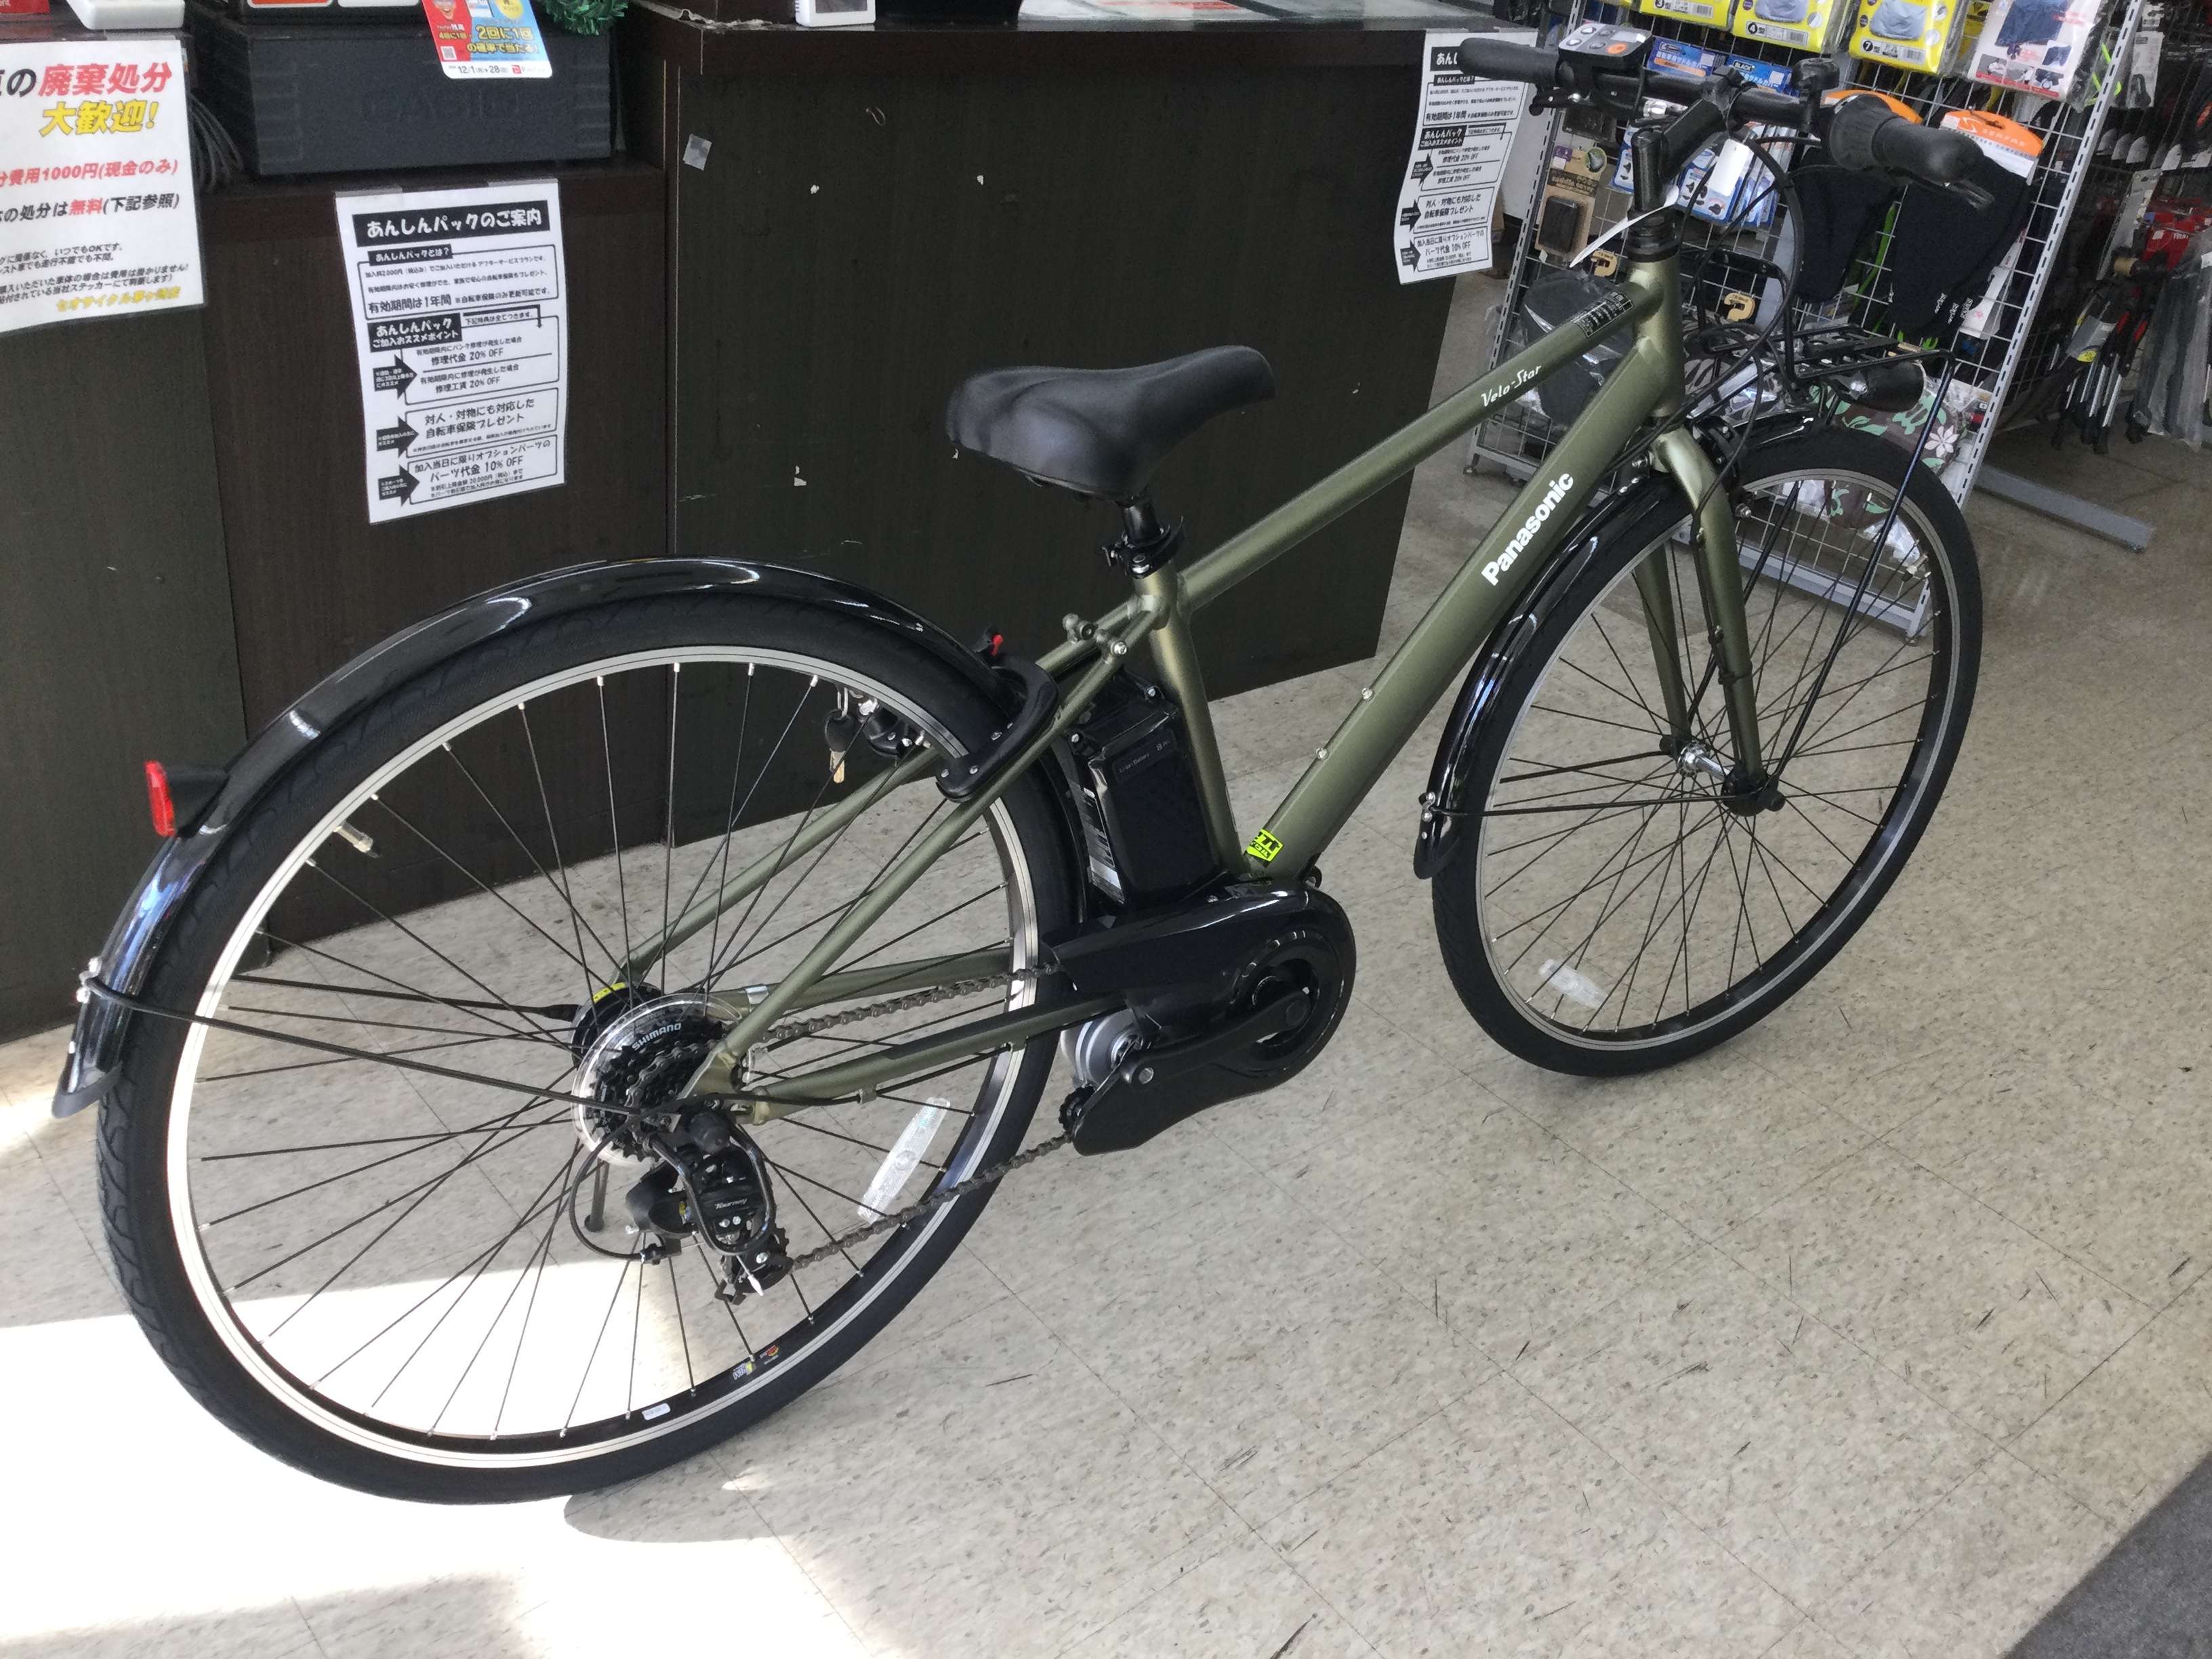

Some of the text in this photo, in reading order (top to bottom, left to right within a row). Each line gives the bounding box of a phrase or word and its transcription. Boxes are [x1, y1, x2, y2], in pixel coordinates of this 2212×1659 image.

[0, 62, 171, 97] の廃棄処分
[39, 99, 159, 137] 大歓迎!
[0, 192, 180, 223] の処分は無料(下記参照)
[367, 207, 542, 239] あんしんパックのご案内
[375, 247, 449, 262] あんしんパックとは?
[368, 294, 451, 314] 有効期間は1年間
[376, 317, 452, 337] あんしんパック
[470, 349, 487, 361] 20%
[488, 347, 504, 358] OFF
[469, 377, 485, 389] 20%
[487, 375, 501, 386] OFF
[1481, 365, 1542, 407] Velo-Star
[425, 398, 535, 426] 対人・対物にも対応した
[426, 413, 525, 439] 自転車保険プレゼント
[430, 455, 523, 483] パーツ代金 10% OFF
[1481, 472, 1574, 586] Panasonic
[632, 1023, 682, 1051] SHIMANO
[714, 1197, 747, 1210] Tourney
